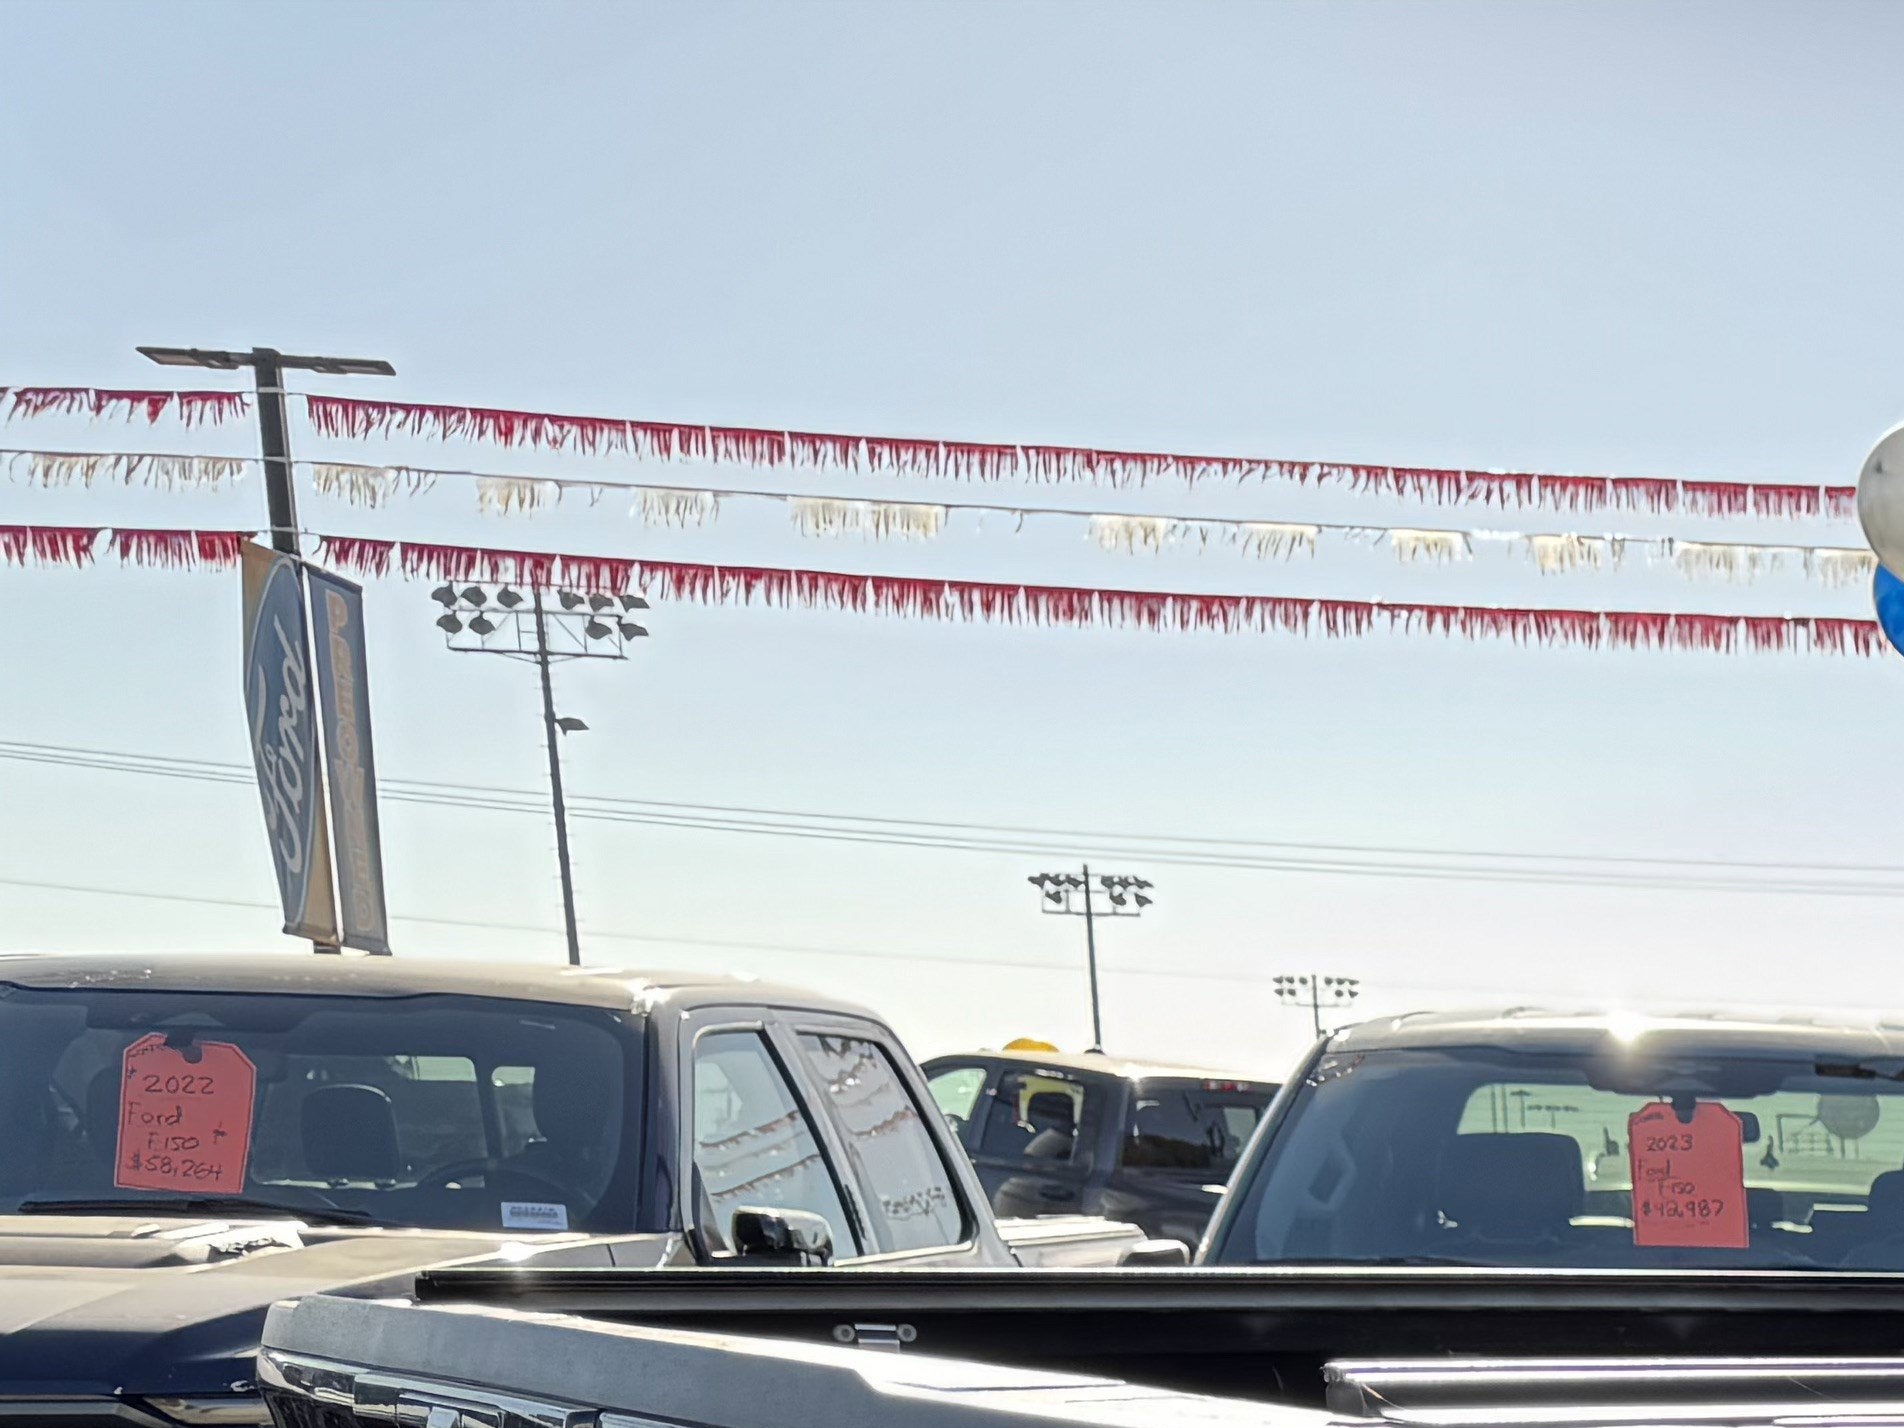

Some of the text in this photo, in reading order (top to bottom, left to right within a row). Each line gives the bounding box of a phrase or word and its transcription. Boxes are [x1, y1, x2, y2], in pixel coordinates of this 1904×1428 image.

[255, 613, 306, 874] Ford
[142, 1074, 214, 1095] 2022
[127, 1101, 183, 1126] Ford
[1646, 1133, 1694, 1152] 2023
[127, 1152, 222, 1181] $58,264
